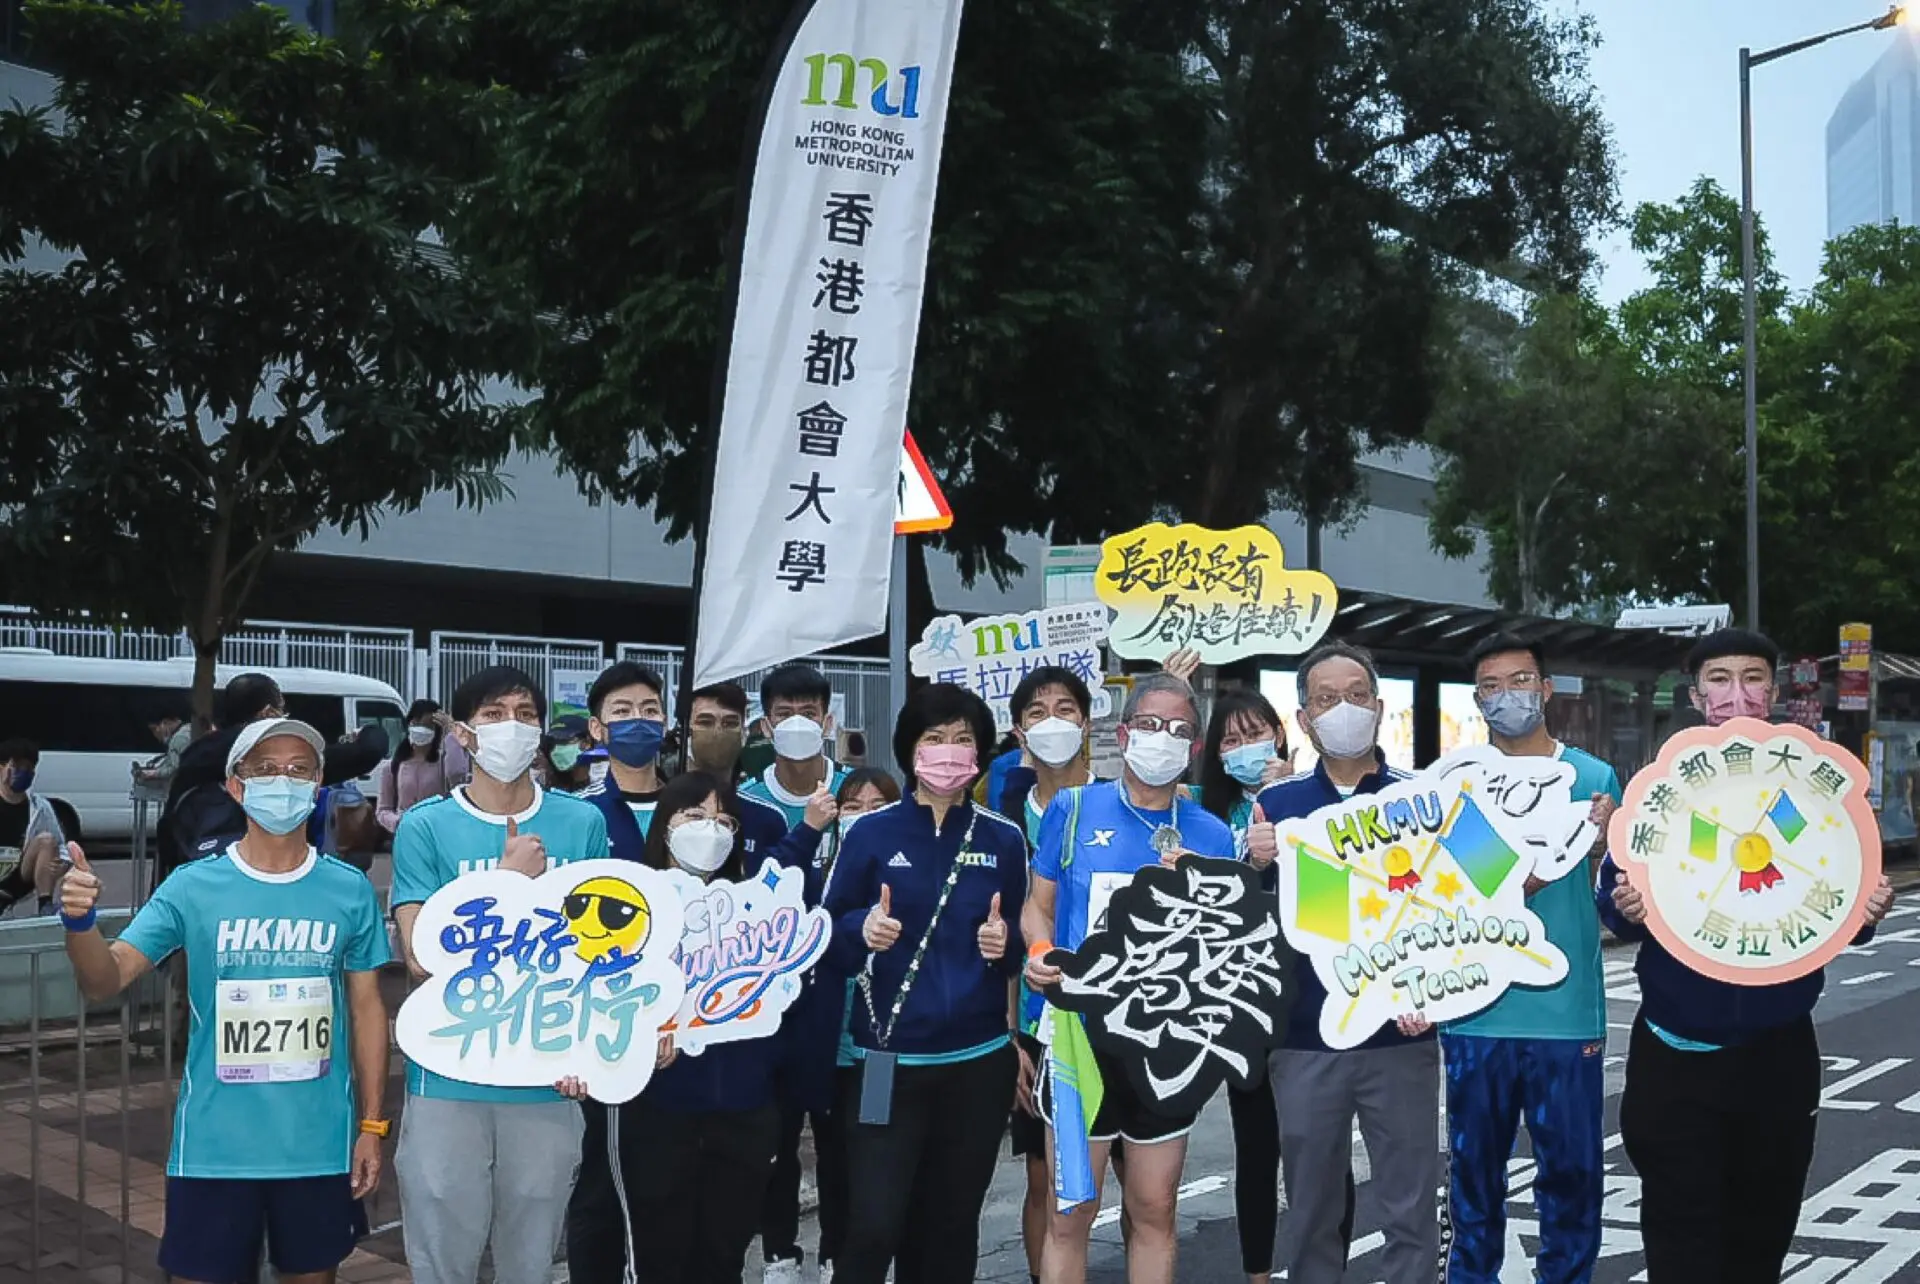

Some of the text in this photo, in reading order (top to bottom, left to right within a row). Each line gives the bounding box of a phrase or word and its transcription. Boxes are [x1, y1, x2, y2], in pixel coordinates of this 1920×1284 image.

[795, 136, 914, 161] METROPOLITAN
[811, 120, 904, 145] HONG KONG
[807, 153, 900, 177] UNIVERSITY
[775, 191, 874, 592] 香港都會大學
[1631, 741, 1847, 857] 香港都會大學
[1326, 790, 1444, 860] HKMU
[217, 918, 336, 953] HKMU
[439, 896, 579, 974] 唔好
[1694, 878, 1845, 958] 馬拉松隊
[217, 952, 246, 967] RUN
[250, 952, 271, 966] TO
[1333, 905, 1530, 998] Marathon
[1392, 962, 1489, 1010] Team
[223, 1015, 330, 1054] M2716
